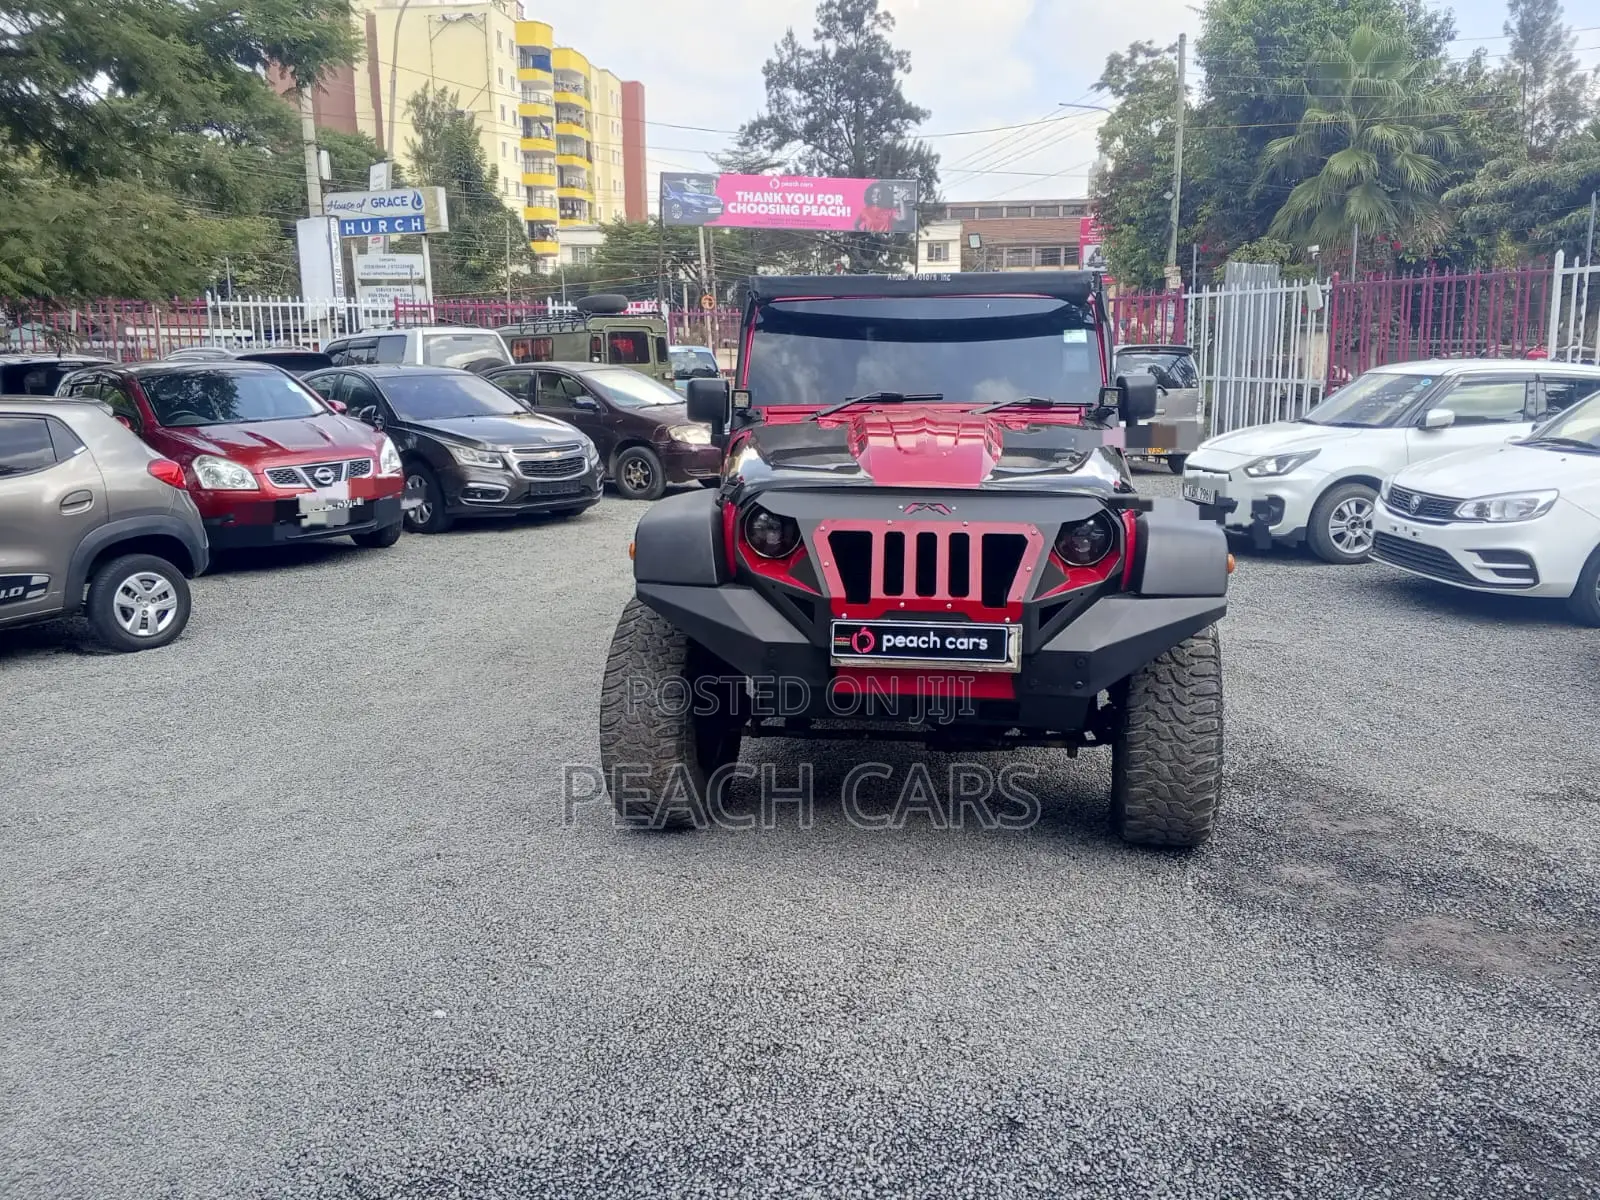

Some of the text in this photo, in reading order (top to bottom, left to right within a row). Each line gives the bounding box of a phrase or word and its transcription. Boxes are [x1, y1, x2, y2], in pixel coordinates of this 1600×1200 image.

[327, 196, 409, 213] House of GRACE
[735, 191, 844, 206] THANK YOU FOR
[728, 202, 851, 217] CHOOSING PEACH!
[345, 218, 421, 234] HURCH
[882, 631, 988, 652] peach cars
